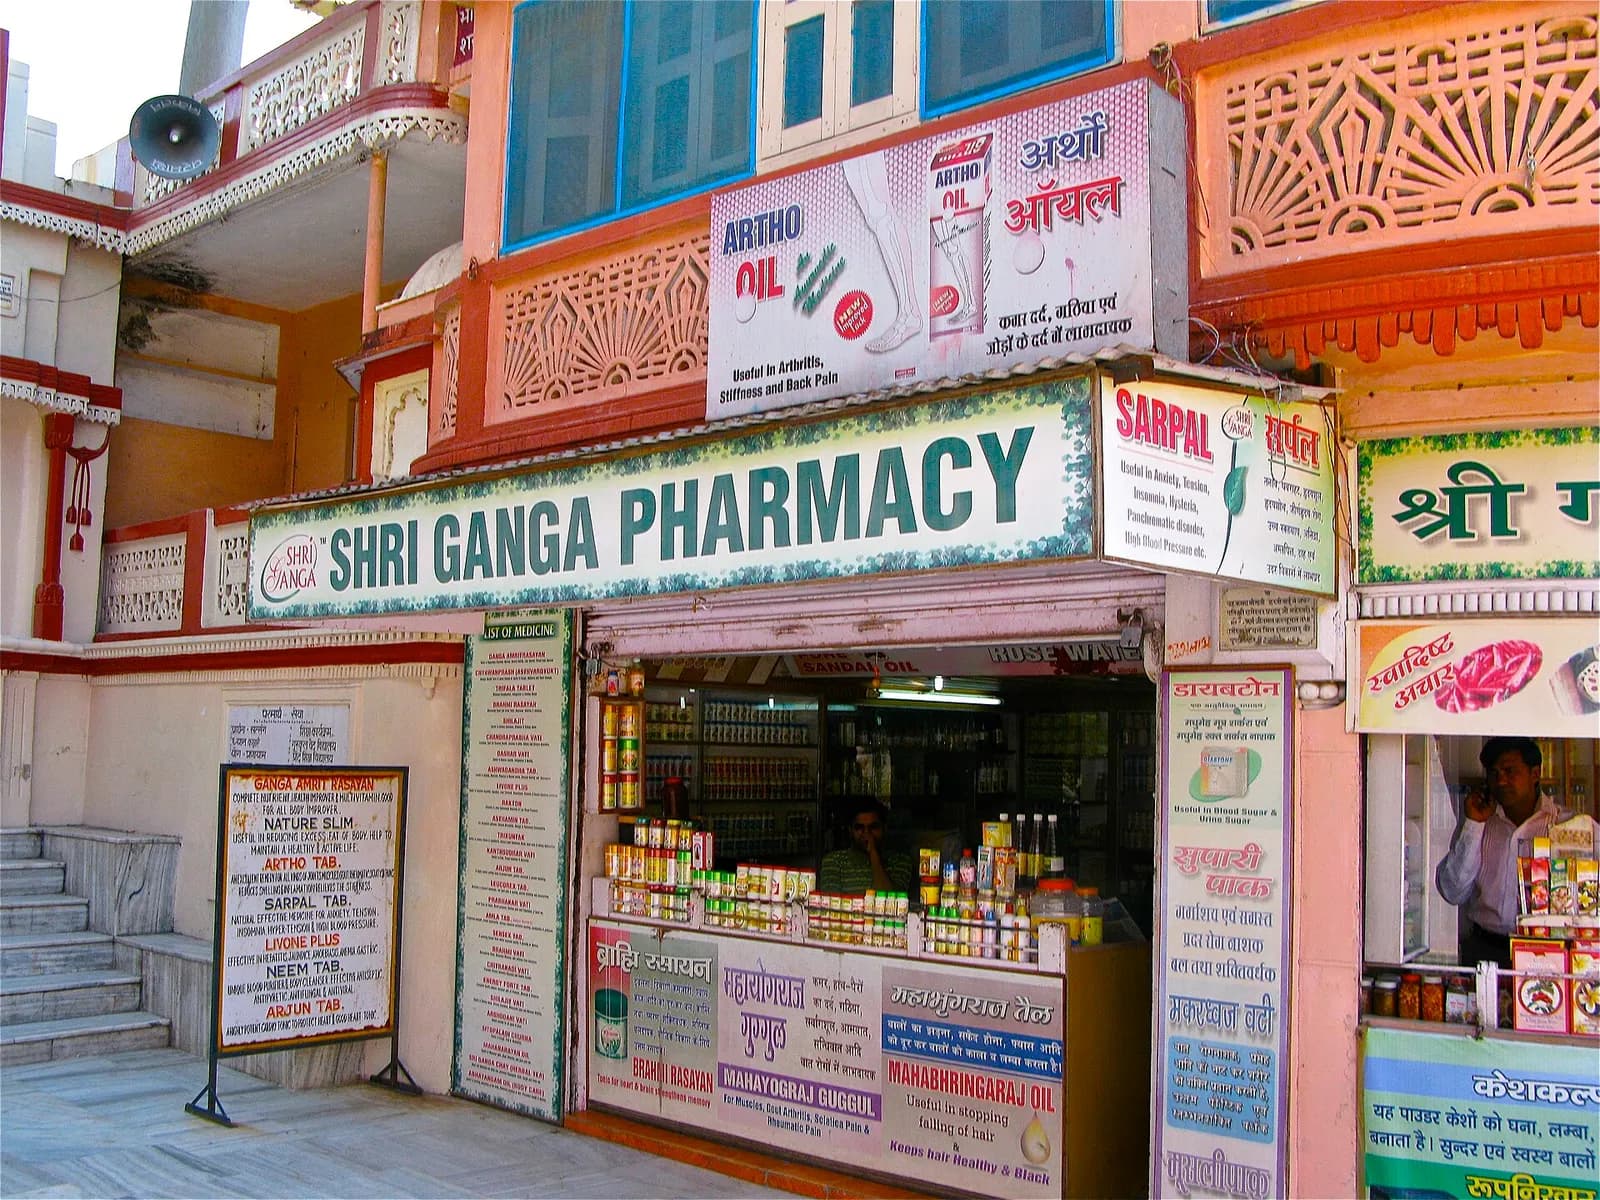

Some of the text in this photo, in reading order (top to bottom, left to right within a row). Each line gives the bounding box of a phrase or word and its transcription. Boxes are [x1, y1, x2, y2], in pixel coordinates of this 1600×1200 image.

[1020, 111, 1106, 169] अर्थो
[935, 162, 980, 188] ARTHO
[1004, 176, 1122, 233] ऑयल
[723, 204, 801, 256] ARTHO
[736, 256, 784, 302] OIL
[733, 366, 763, 383] Useful
[778, 355, 824, 374] Arthritis,
[719, 371, 839, 404] Stiffness and Back Pain
[1116, 387, 1214, 461] SARPAL
[1120, 459, 1144, 479] Useful
[1154, 468, 1182, 489] Anxiety,
[1183, 476, 1210, 496] Tension,
[330, 425, 1036, 592] SHRI GANGA PHARMACY
[1133, 485, 1168, 508] Insomnia,
[1391, 461, 1525, 540] श्री
[287, 537, 313, 566] SHRI
[266, 557, 317, 592] GANGA
[502, 625, 513, 638] OF
[514, 623, 555, 637] MEDICINE
[803, 661, 919, 673] SANDAL OIL
[989, 643, 1145, 662] ROSE WATE
[1367, 631, 1455, 692] स्वादिष्ट
[1173, 676, 1281, 698] डायबटोन
[1394, 662, 1456, 709] अचार
[254, 777, 375, 791] GANGA AMRIT RASAYAN
[265, 816, 353, 831] NATURE SLIM
[1174, 805, 1201, 814] Useful
[1214, 806, 1239, 815] Blood
[1241, 807, 1268, 818] Sugar
[1270, 808, 1277, 817] &
[1199, 815, 1251, 825] Urine Sugar
[312, 855, 342, 869] TAB.
[1173, 842, 1263, 874] सुपारी
[1205, 874, 1273, 897] पाक
[265, 894, 352, 911] SARPAL TAB.
[265, 933, 340, 951] LIVONE PLUS
[266, 960, 344, 979] NEEM TAB.
[644, 951, 713, 984] रसायन
[723, 957, 806, 1010] महायोगराज
[265, 998, 345, 1019] ARJUN TAB.
[1013, 995, 1053, 1024] तैल
[1168, 993, 1275, 1034] मकरध्वज वटी
[741, 1011, 787, 1062] गुग्गुल
[670, 1064, 714, 1094] RASAYAN
[723, 1068, 876, 1117] MAHAYOGRAJ GUGGUL
[888, 1059, 1056, 1114] MAHABHRINGARAJ OIL
[723, 1093, 735, 1104] For
[735, 1095, 765, 1112] Muscles,
[845, 1118, 862, 1132] Pain
[863, 1127, 870, 1135] &
[767, 1115, 822, 1137] Rheumatic Pain
[906, 1094, 1009, 1128] Useful in stopping
[1373, 1104, 1595, 1144] यह पाउडर केशों को घना, लम्बा,
[919, 1116, 995, 1143] falling of hair
[890, 1140, 1050, 1186] Keeps hair Healthy & Black
[952, 1142, 960, 1153] &
[1369, 1131, 1411, 1150] बनाता
[1439, 1138, 1479, 1160] सुन्दर
[1483, 1140, 1505, 1161] एवं
[1511, 1146, 1553, 1166] स्वस्थ
[1558, 1147, 1596, 1171] बालों
